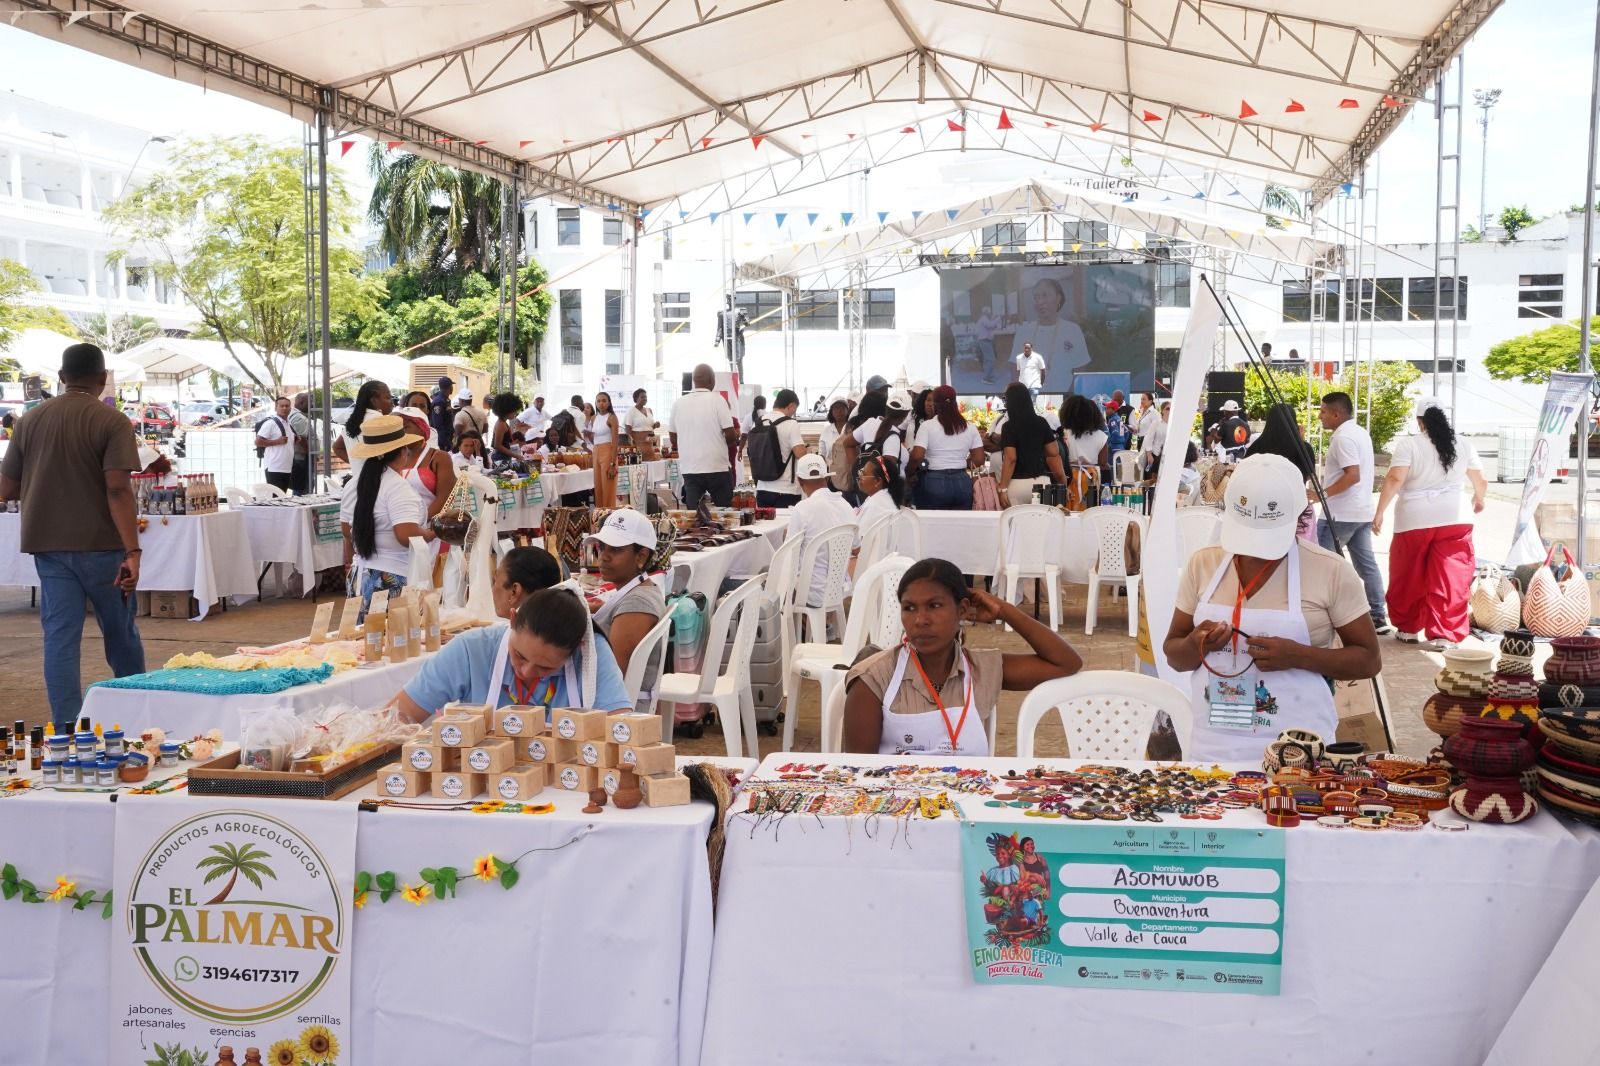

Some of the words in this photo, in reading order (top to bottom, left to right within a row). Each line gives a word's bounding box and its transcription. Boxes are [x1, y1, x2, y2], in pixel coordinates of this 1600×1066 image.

[149, 825, 209, 877] PRODUCTOS
[214, 821, 321, 879] AGROECOLÓGICOS
[1113, 840, 1149, 848] Agricultura
[1153, 865, 1185, 873] Nombre
[1113, 867, 1219, 888] ASOMUWOB
[169, 888, 198, 906] EL
[1151, 894, 1187, 903] Municipio
[1113, 898, 1209, 918] Buenaventura
[132, 903, 341, 954] PALMAR
[1141, 923, 1198, 932] Departamento
[1085, 926, 1118, 943] Valle
[1125, 930, 1144, 944] del
[1153, 932, 1187, 945] Cauca
[974, 947, 1063, 968] ETNOAGROFERIA
[202, 966, 300, 984] 3194617317
[988, 965, 1010, 977] para
[1011, 965, 1020, 973] la
[1021, 966, 1044, 979] Vida
[128, 1004, 173, 1016] jabones
[123, 1019, 186, 1030] artesanales
[297, 1014, 341, 1026] semillas
[209, 1027, 256, 1038] esencias
